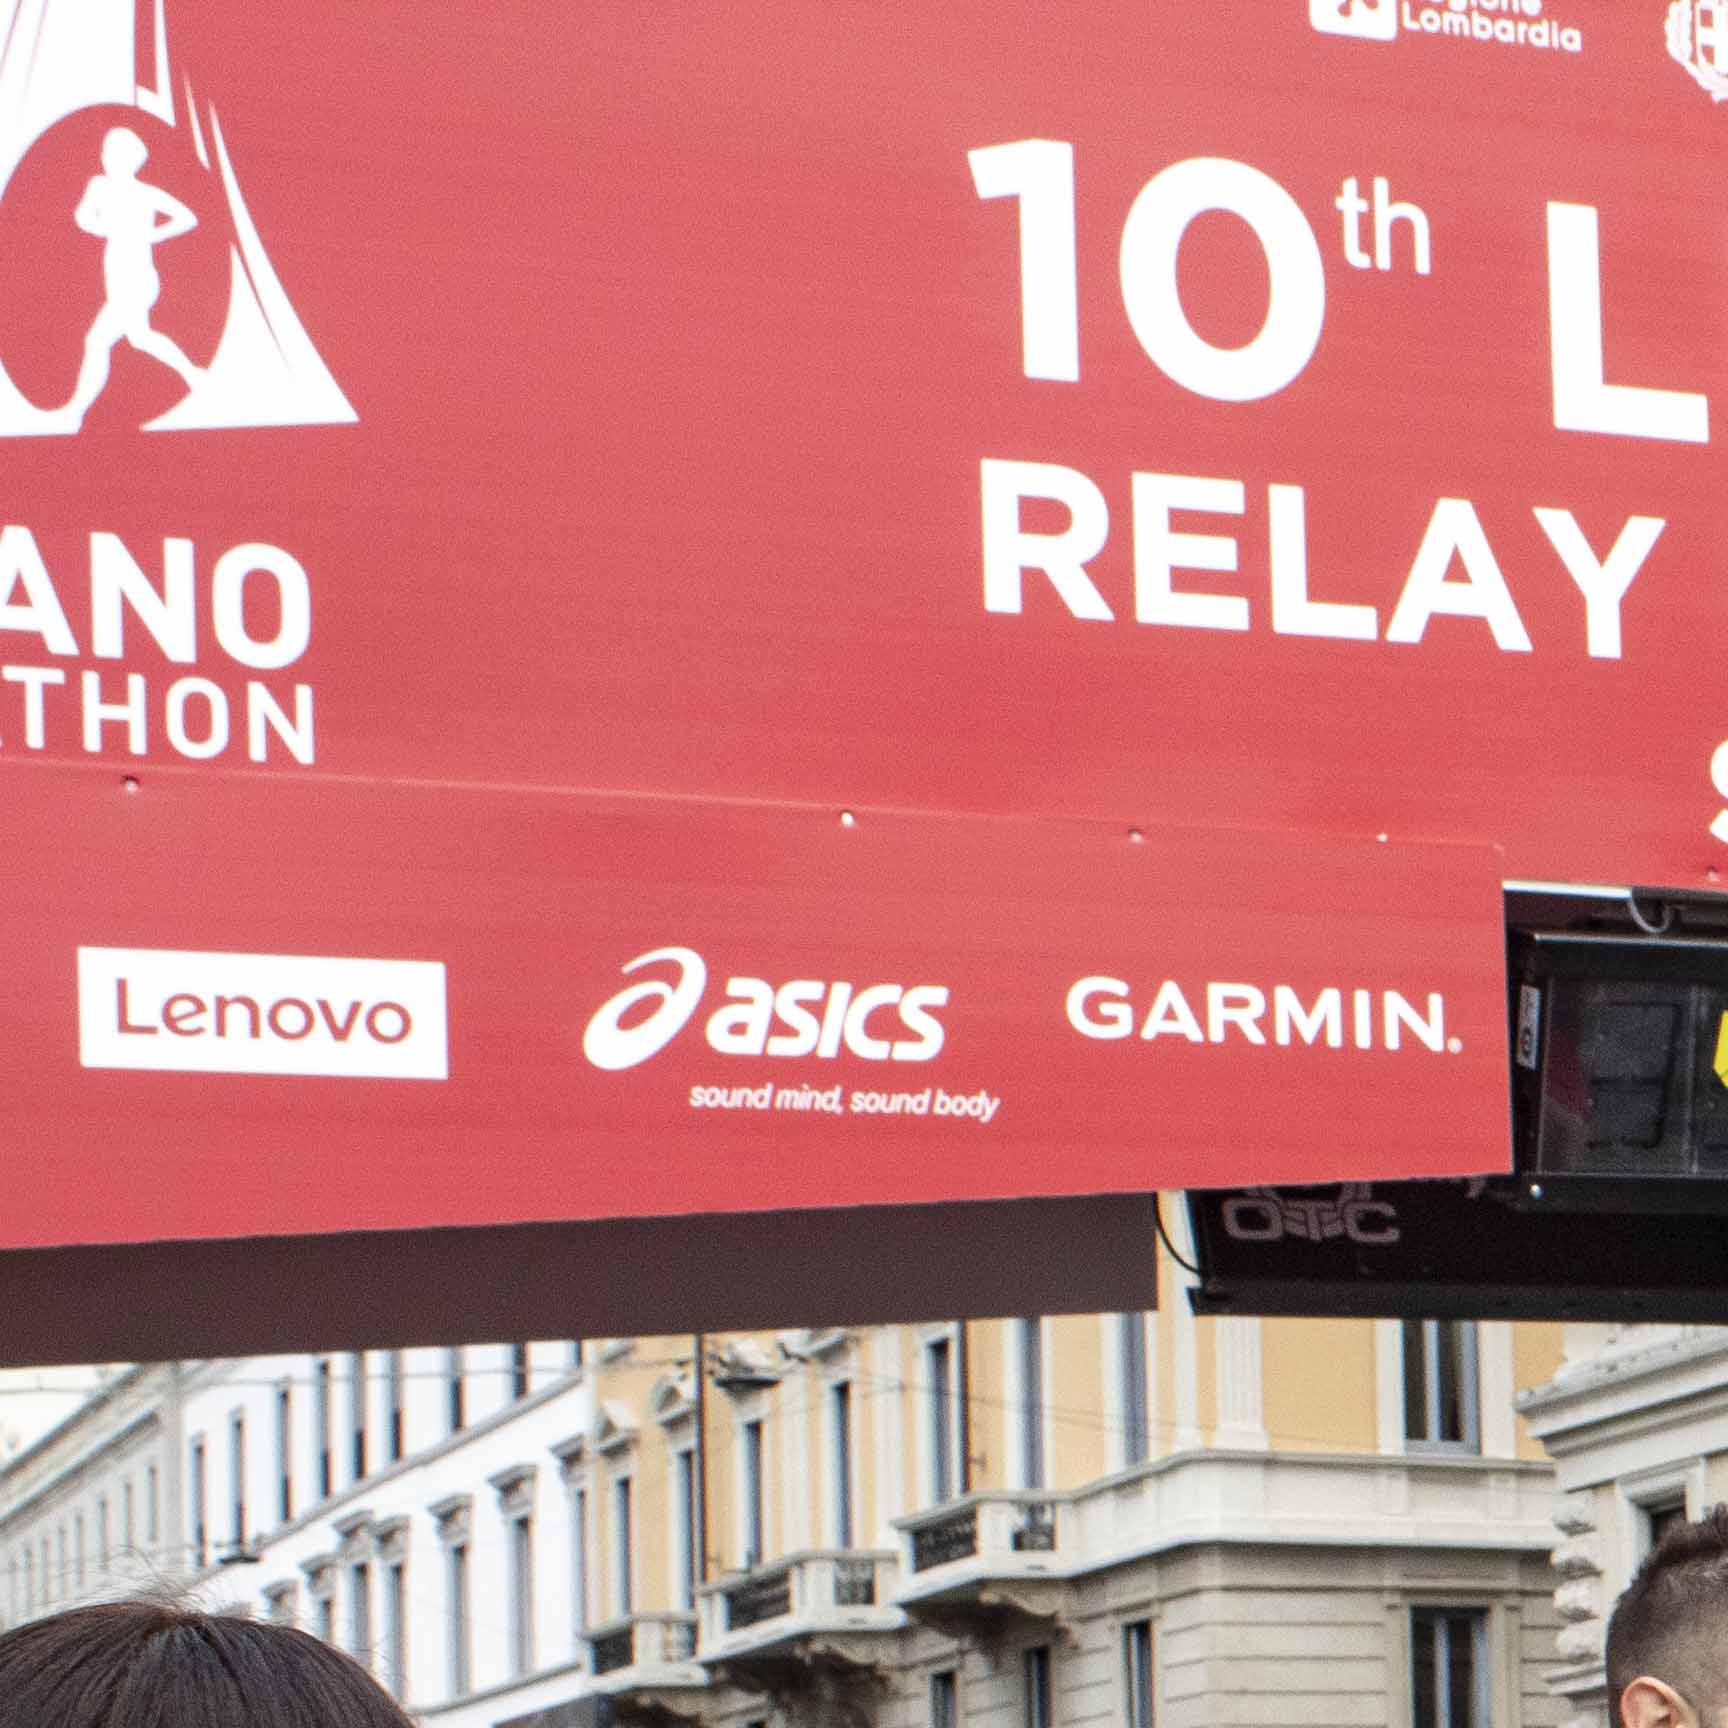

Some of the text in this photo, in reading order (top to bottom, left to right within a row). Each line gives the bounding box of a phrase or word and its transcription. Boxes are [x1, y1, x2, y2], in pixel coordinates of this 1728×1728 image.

[1403, 2, 1583, 53] Lombardia
[980, 457, 1667, 660] RELAY
[0, 664, 315, 765] THON
[114, 976, 414, 1046] Lenovo
[690, 1082, 773, 1110] sound
[850, 1088, 931, 1116] sound
[933, 1089, 1001, 1123] body
